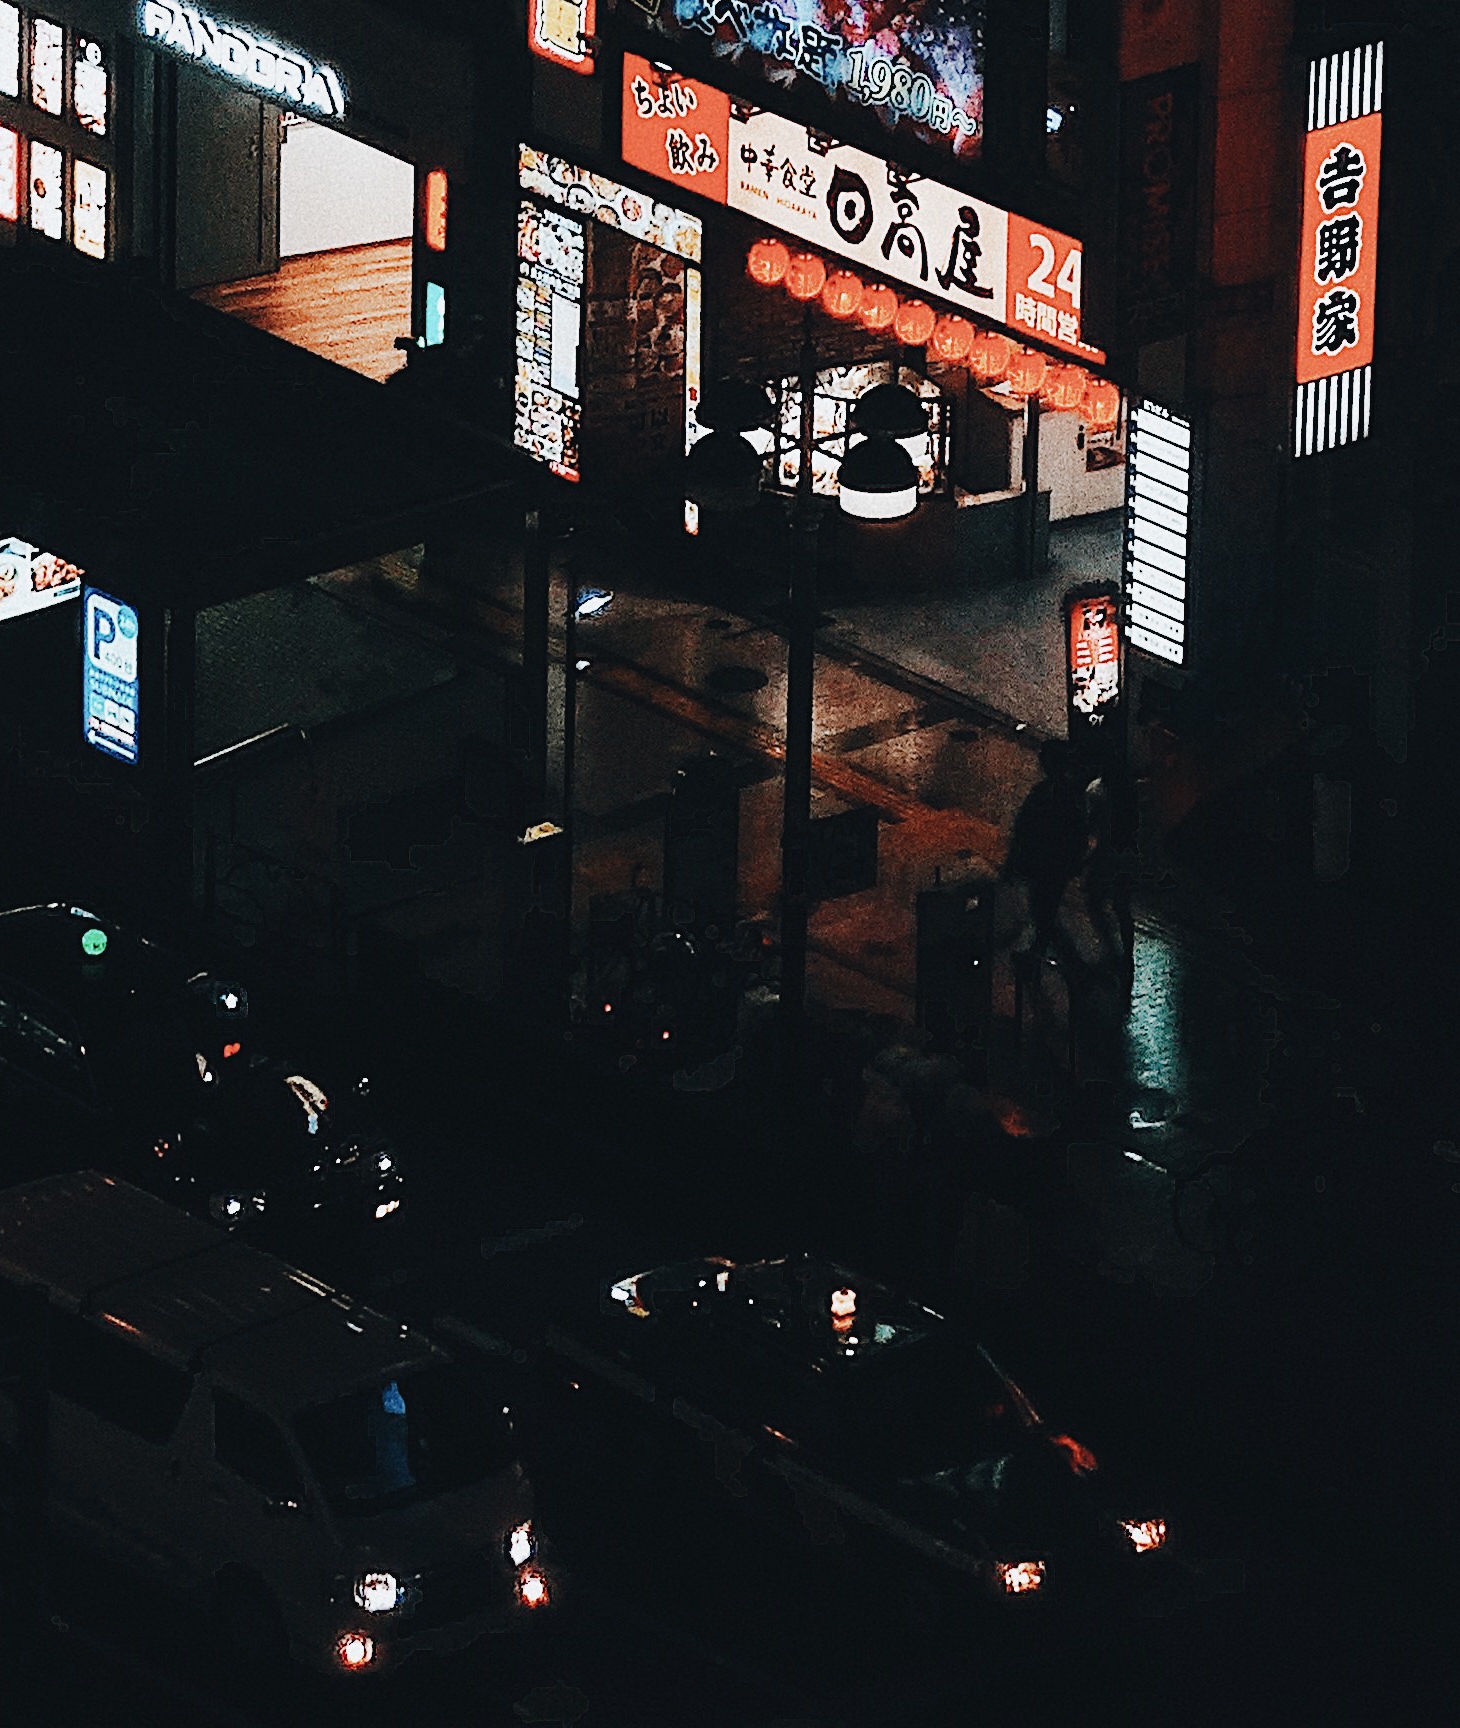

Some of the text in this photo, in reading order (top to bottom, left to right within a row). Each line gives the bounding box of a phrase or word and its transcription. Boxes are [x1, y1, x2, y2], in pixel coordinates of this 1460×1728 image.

[630, 75, 699, 119] ちょい
[665, 127, 721, 176] 飲み
[740, 142, 818, 199] 中華食堂
[826, 164, 995, 300] 日高屋
[1312, 142, 1366, 356] 吉野家
[1027, 231, 1083, 310] 24
[1013, 292, 1099, 353] 時間営
[93, 606, 116, 660] P
